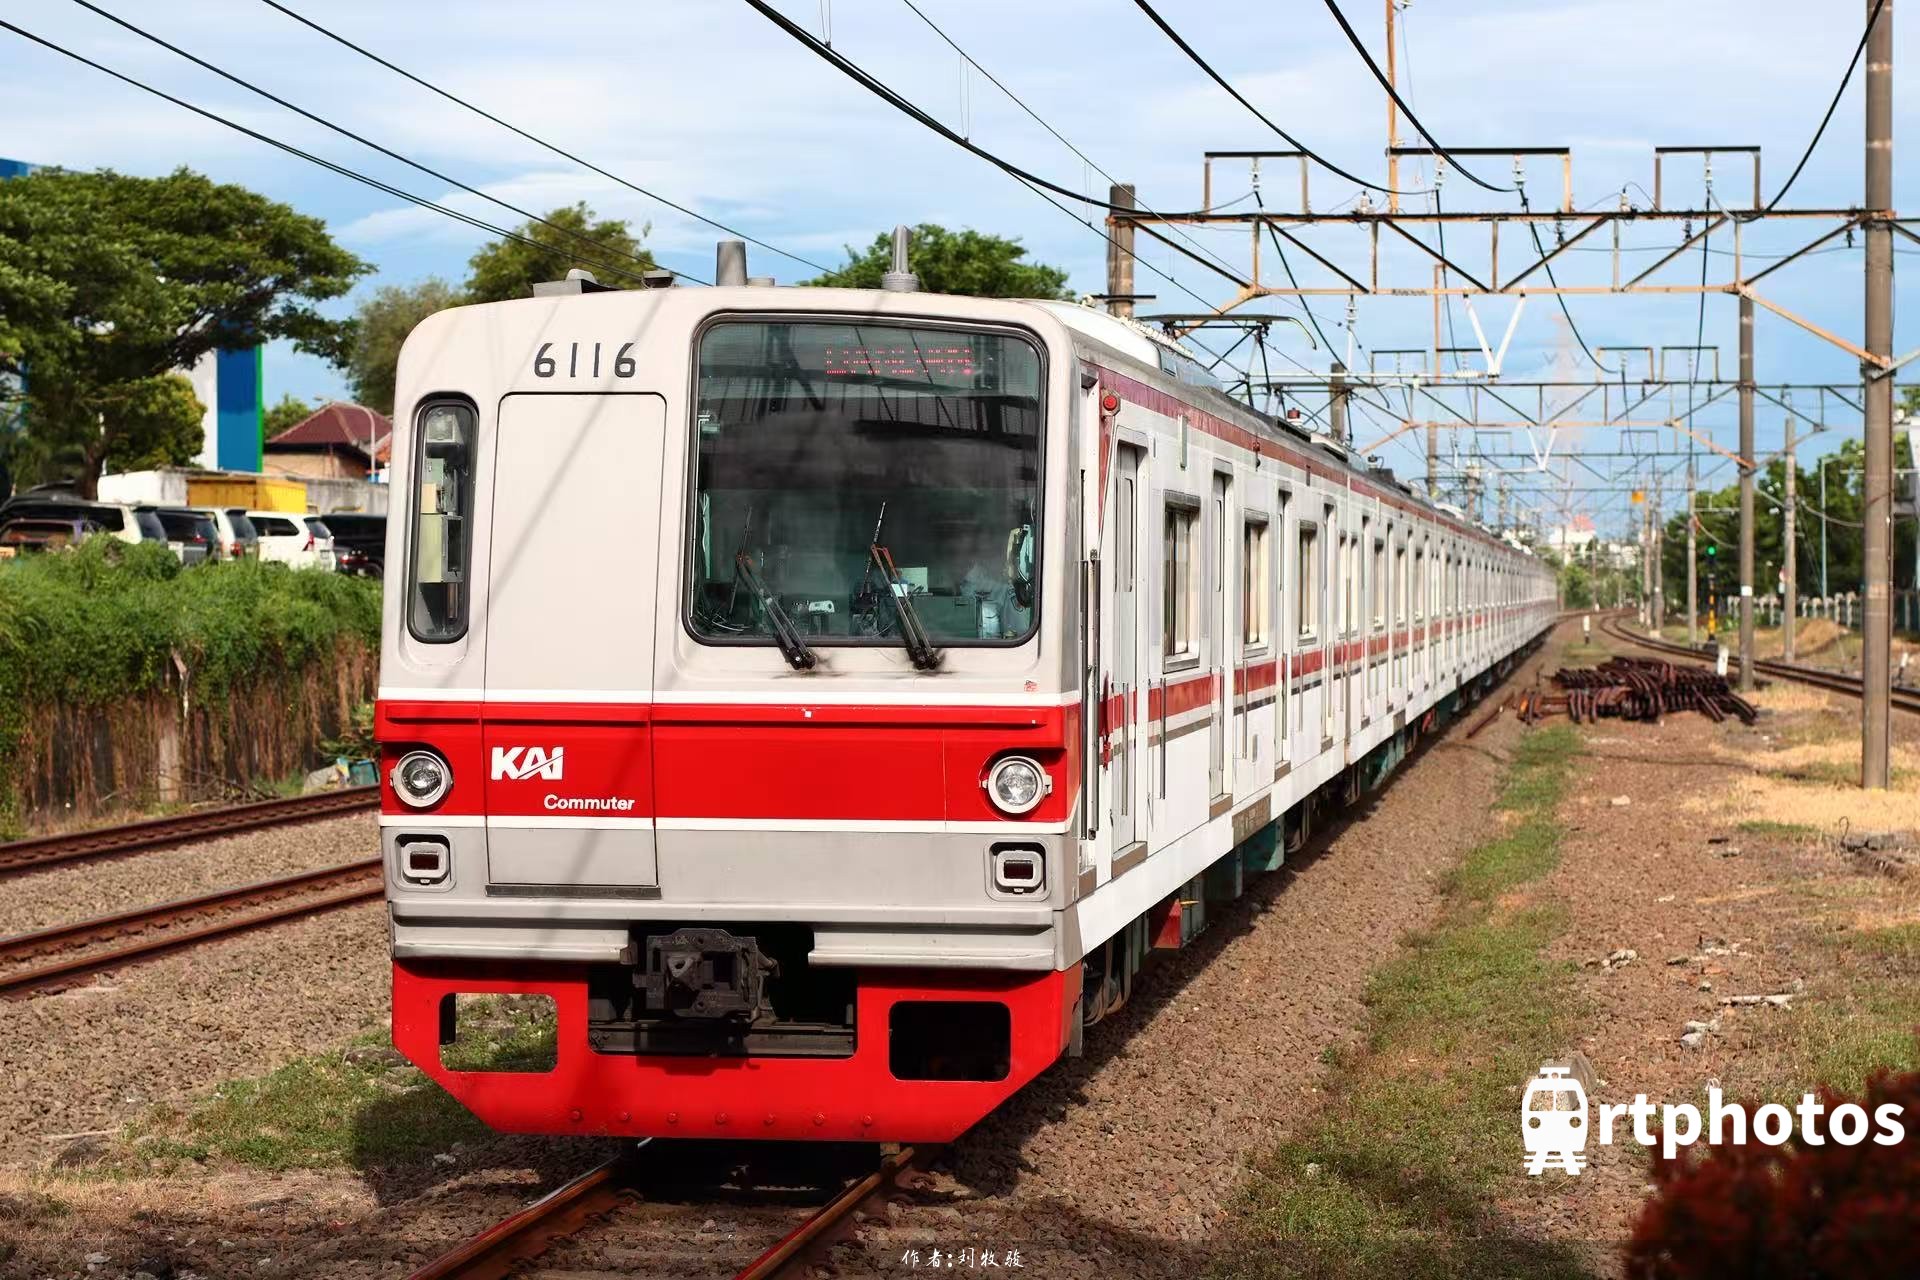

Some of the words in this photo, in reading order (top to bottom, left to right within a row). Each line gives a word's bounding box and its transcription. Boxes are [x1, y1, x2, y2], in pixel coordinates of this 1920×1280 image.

[534, 342, 638, 378] 6116
[490, 746, 564, 781] KAI
[543, 794, 635, 811] Commuter
